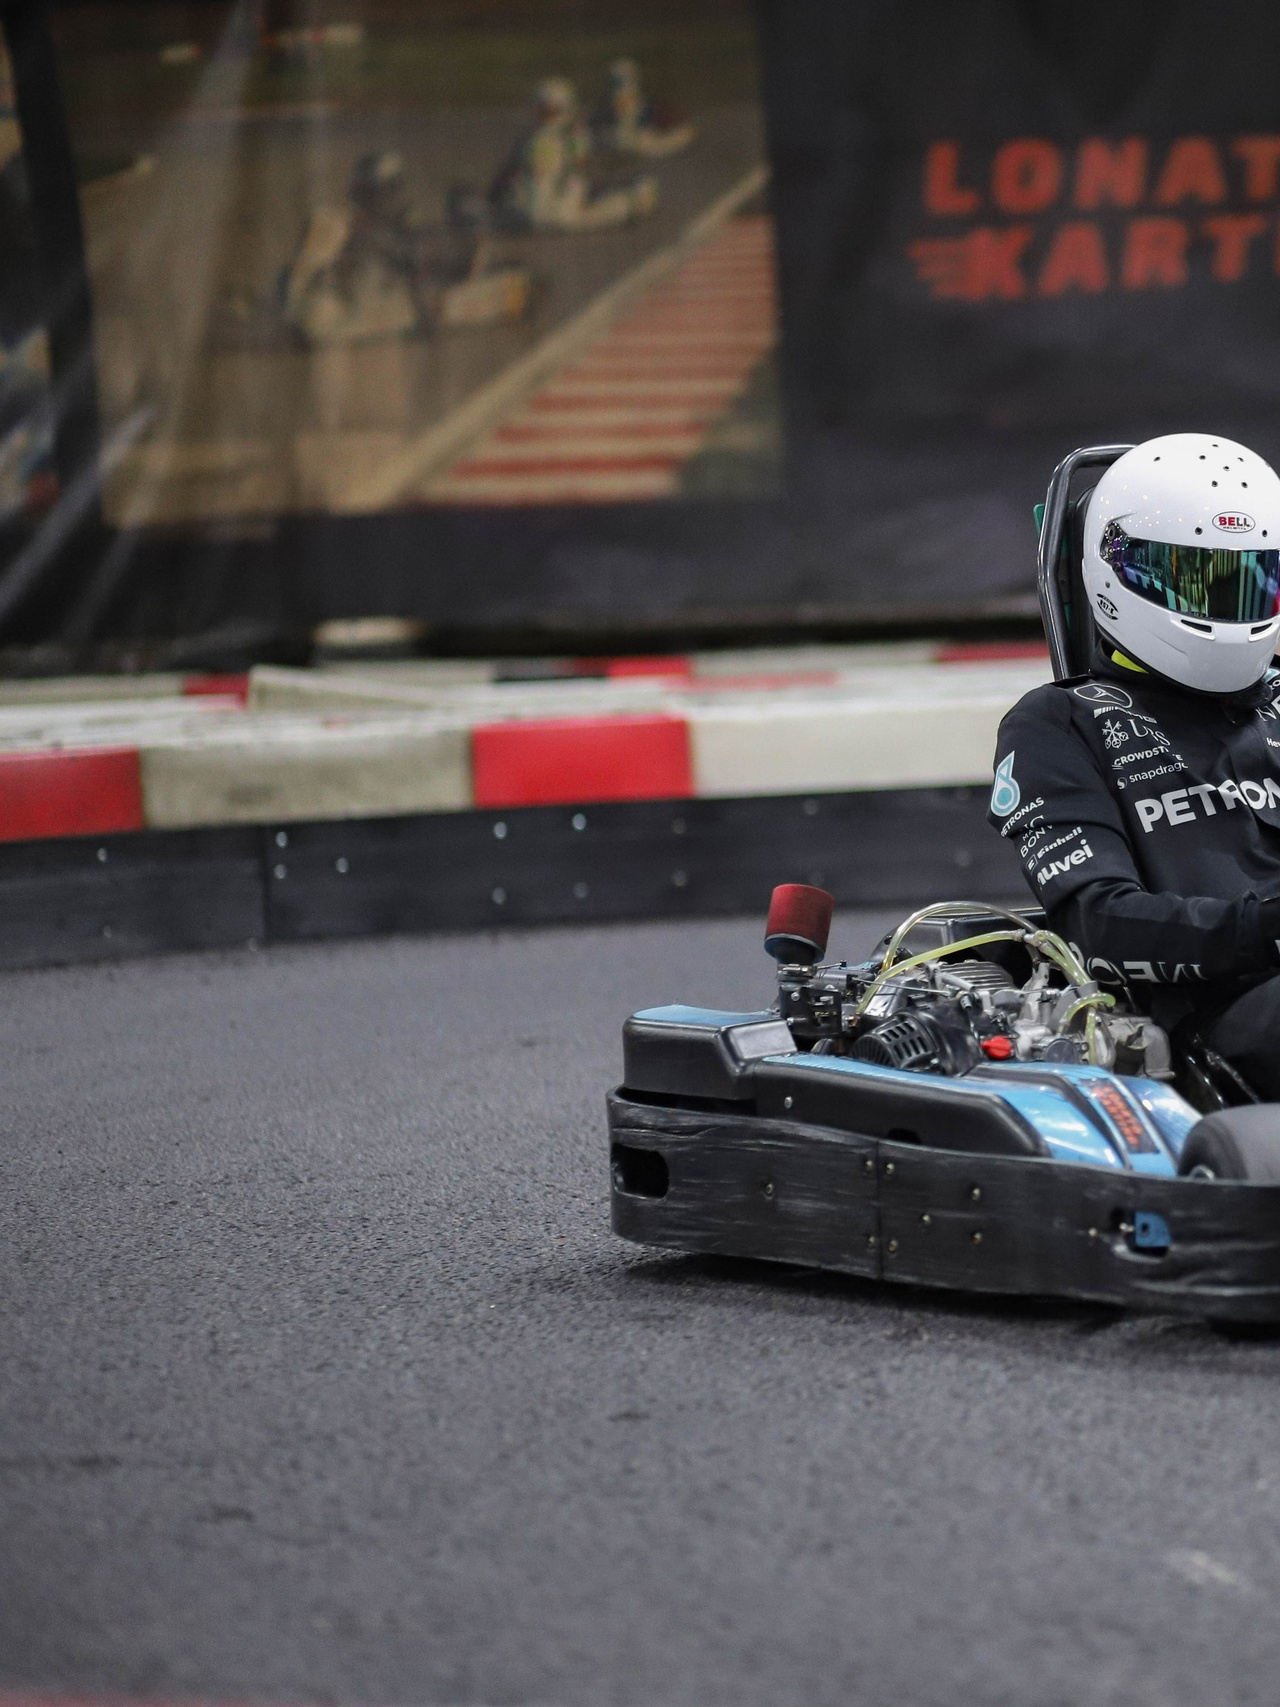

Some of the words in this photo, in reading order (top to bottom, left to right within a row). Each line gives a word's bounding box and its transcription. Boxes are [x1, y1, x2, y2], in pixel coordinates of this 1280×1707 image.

[1218, 516, 1251, 527] BELL
[1129, 762, 1189, 783] snapdrag
[1000, 797, 1045, 838] PETRONAS
